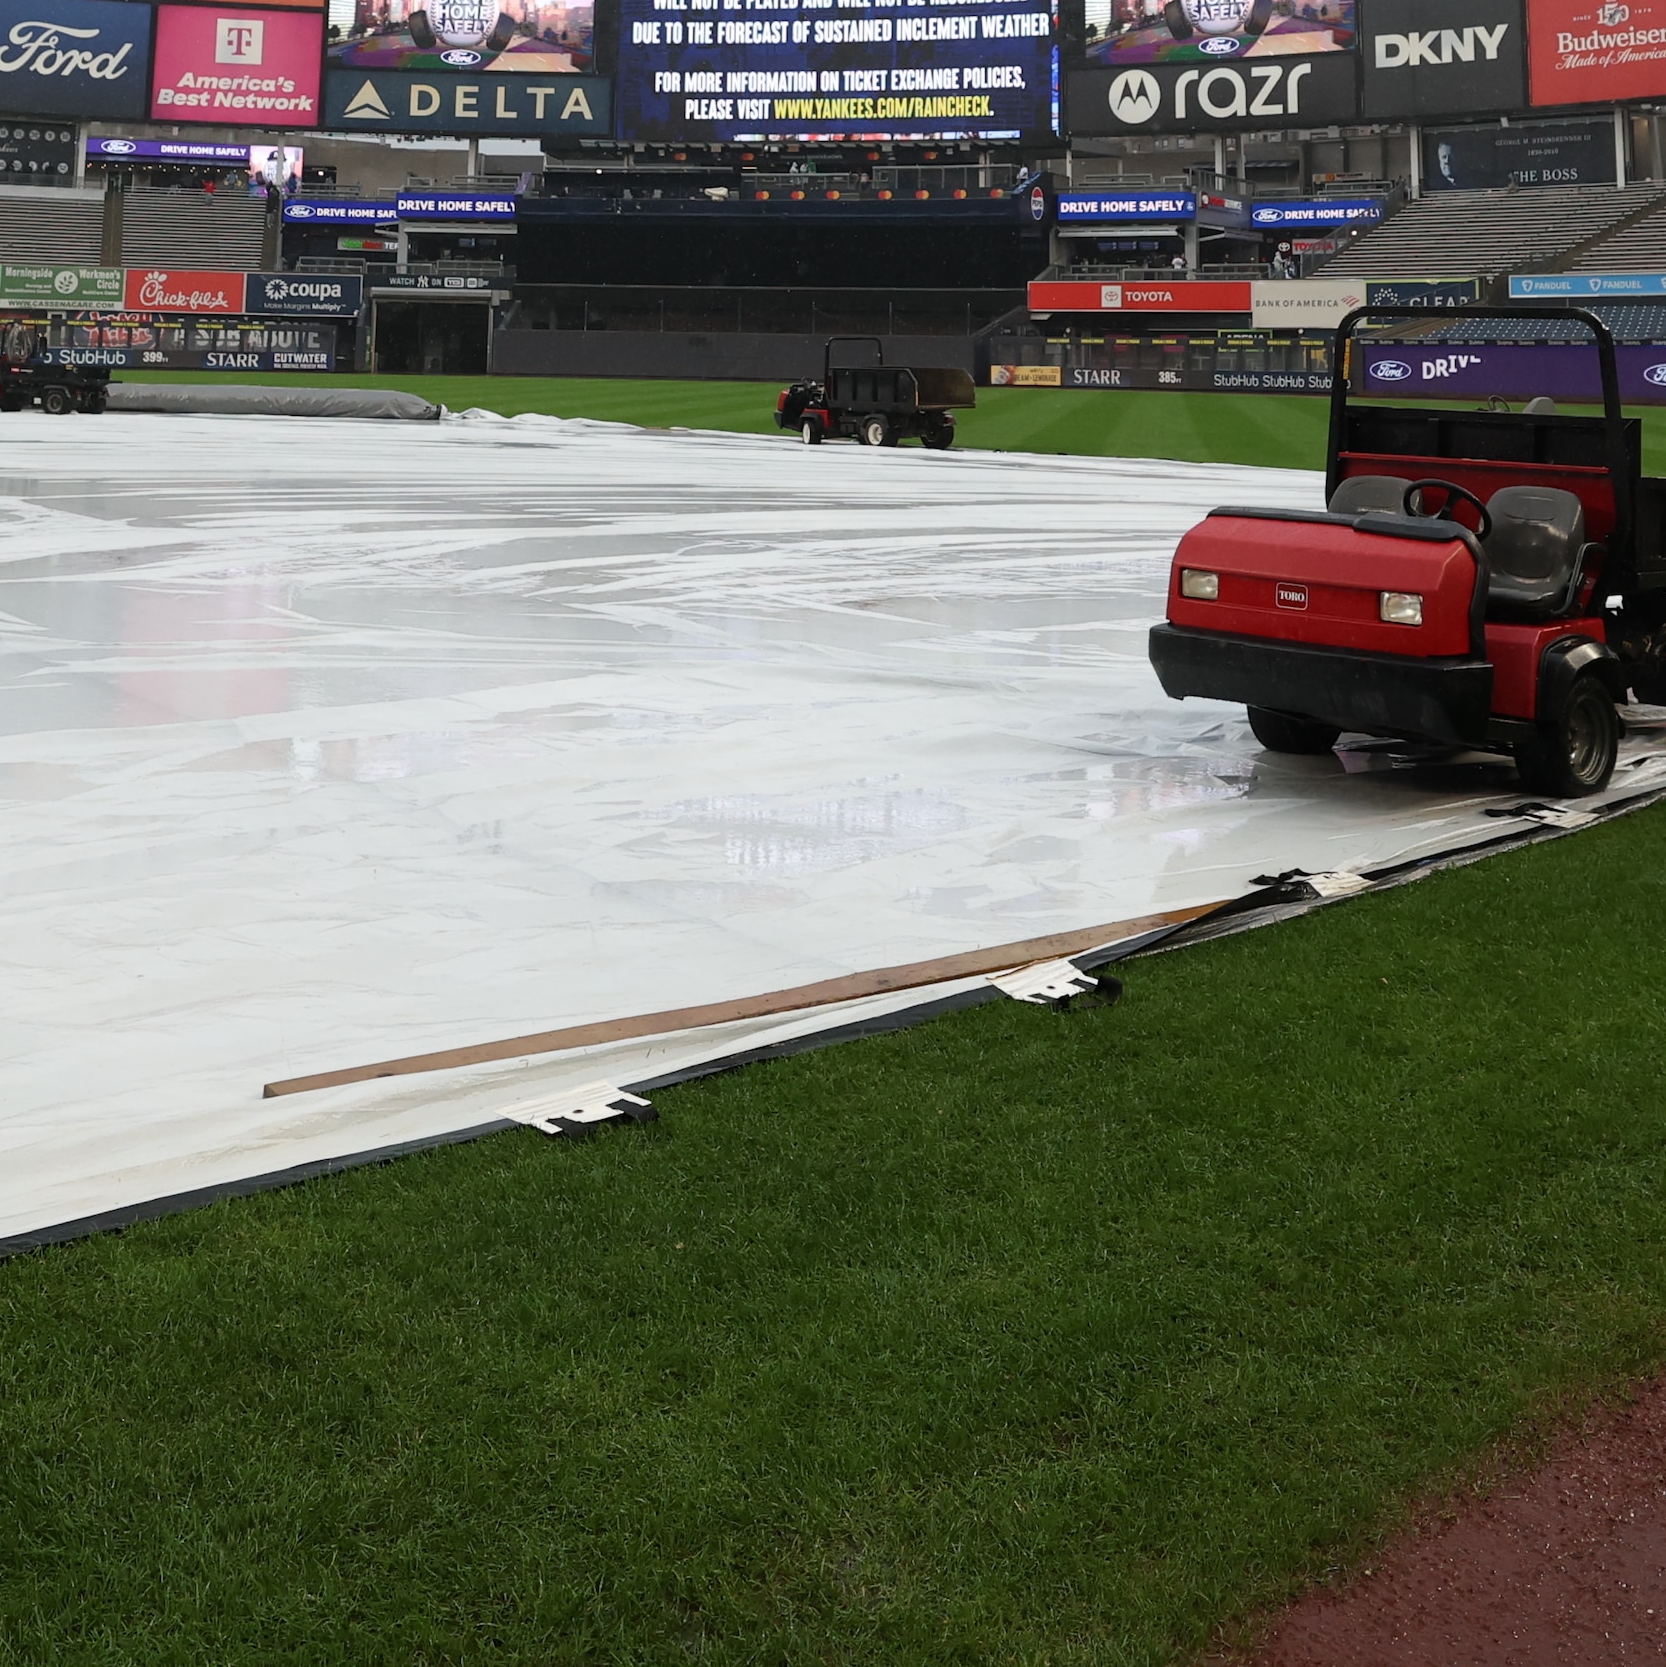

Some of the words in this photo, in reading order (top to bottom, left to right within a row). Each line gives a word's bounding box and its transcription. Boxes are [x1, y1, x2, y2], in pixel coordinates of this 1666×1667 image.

[439, 4, 488, 19] HOME
[1192, 4, 1247, 21] SAFELY
[436, 19, 490, 34] SAFELY
[633, 21, 660, 44] DUE
[665, 22, 682, 44] TO
[687, 21, 713, 44] THE
[717, 21, 789, 44] FORECAST
[792, 21, 811, 43] OF
[814, 19, 891, 43] SUSTAINED
[896, 17, 978, 41] INCLEMENT
[982, 13, 1049, 38] WEATHER
[1374, 24, 1509, 69] DKNY
[176, 72, 295, 92] America's
[655, 72, 680, 92] FOR
[685, 72, 723, 92] MORE
[727, 71, 817, 92] INFORMATION
[820, 71, 839, 92] ON
[843, 69, 888, 91] TICKET
[891, 67, 960, 90] EXCHANGE
[963, 66, 1026, 89] POLICIES,
[1175, 62, 1312, 119] razr
[157, 89, 210, 106] Best
[213, 91, 314, 111] Network
[409, 84, 593, 120] DELTA
[685, 99, 733, 120] PLEASE
[737, 99, 771, 119] VISIT
[774, 95, 994, 119] WWW.YANKEES.COM/RAINCHECK.
[161, 145, 188, 155] DRIVE
[189, 146, 214, 156] HOME
[215, 147, 246, 157] SAFELY
[1543, 168, 1578, 181] BOSS
[398, 200, 435, 211] DRIVE
[438, 200, 473, 212] HOME
[1061, 202, 1098, 213] DRIVE
[1101, 201, 1137, 212] HOME
[1139, 200, 1184, 212] SAFELY
[317, 208, 346, 218] DRIVE
[348, 209, 375, 219] HOME
[1285, 210, 1314, 220] DRIVE
[1317, 209, 1344, 219] HOME
[6, 267, 53, 279] Morningside
[79, 269, 120, 279] Workmen's
[97, 279, 120, 290] Circle
[1534, 281, 1572, 290] FANDUEL
[1603, 280, 1642, 289] FANDUEL
[140, 280, 228, 308] Chick-fil-A
[290, 283, 342, 300] coupa
[1125, 290, 1173, 302] TOYOTA
[9, 300, 114, 309] WWW.CASSENACARE.COM
[1256, 298, 1282, 307] BANK
[1283, 299, 1295, 307] OF
[1296, 298, 1339, 308] AMERICA
[59, 349, 126, 365] StubHub
[207, 352, 259, 368] STARR
[274, 352, 327, 363] CUTWATER
[1074, 369, 1121, 384] STARR
[1214, 374, 1259, 387] StubHub
[1263, 375, 1305, 388] StubHub
[1279, 590, 1305, 602] TORO
